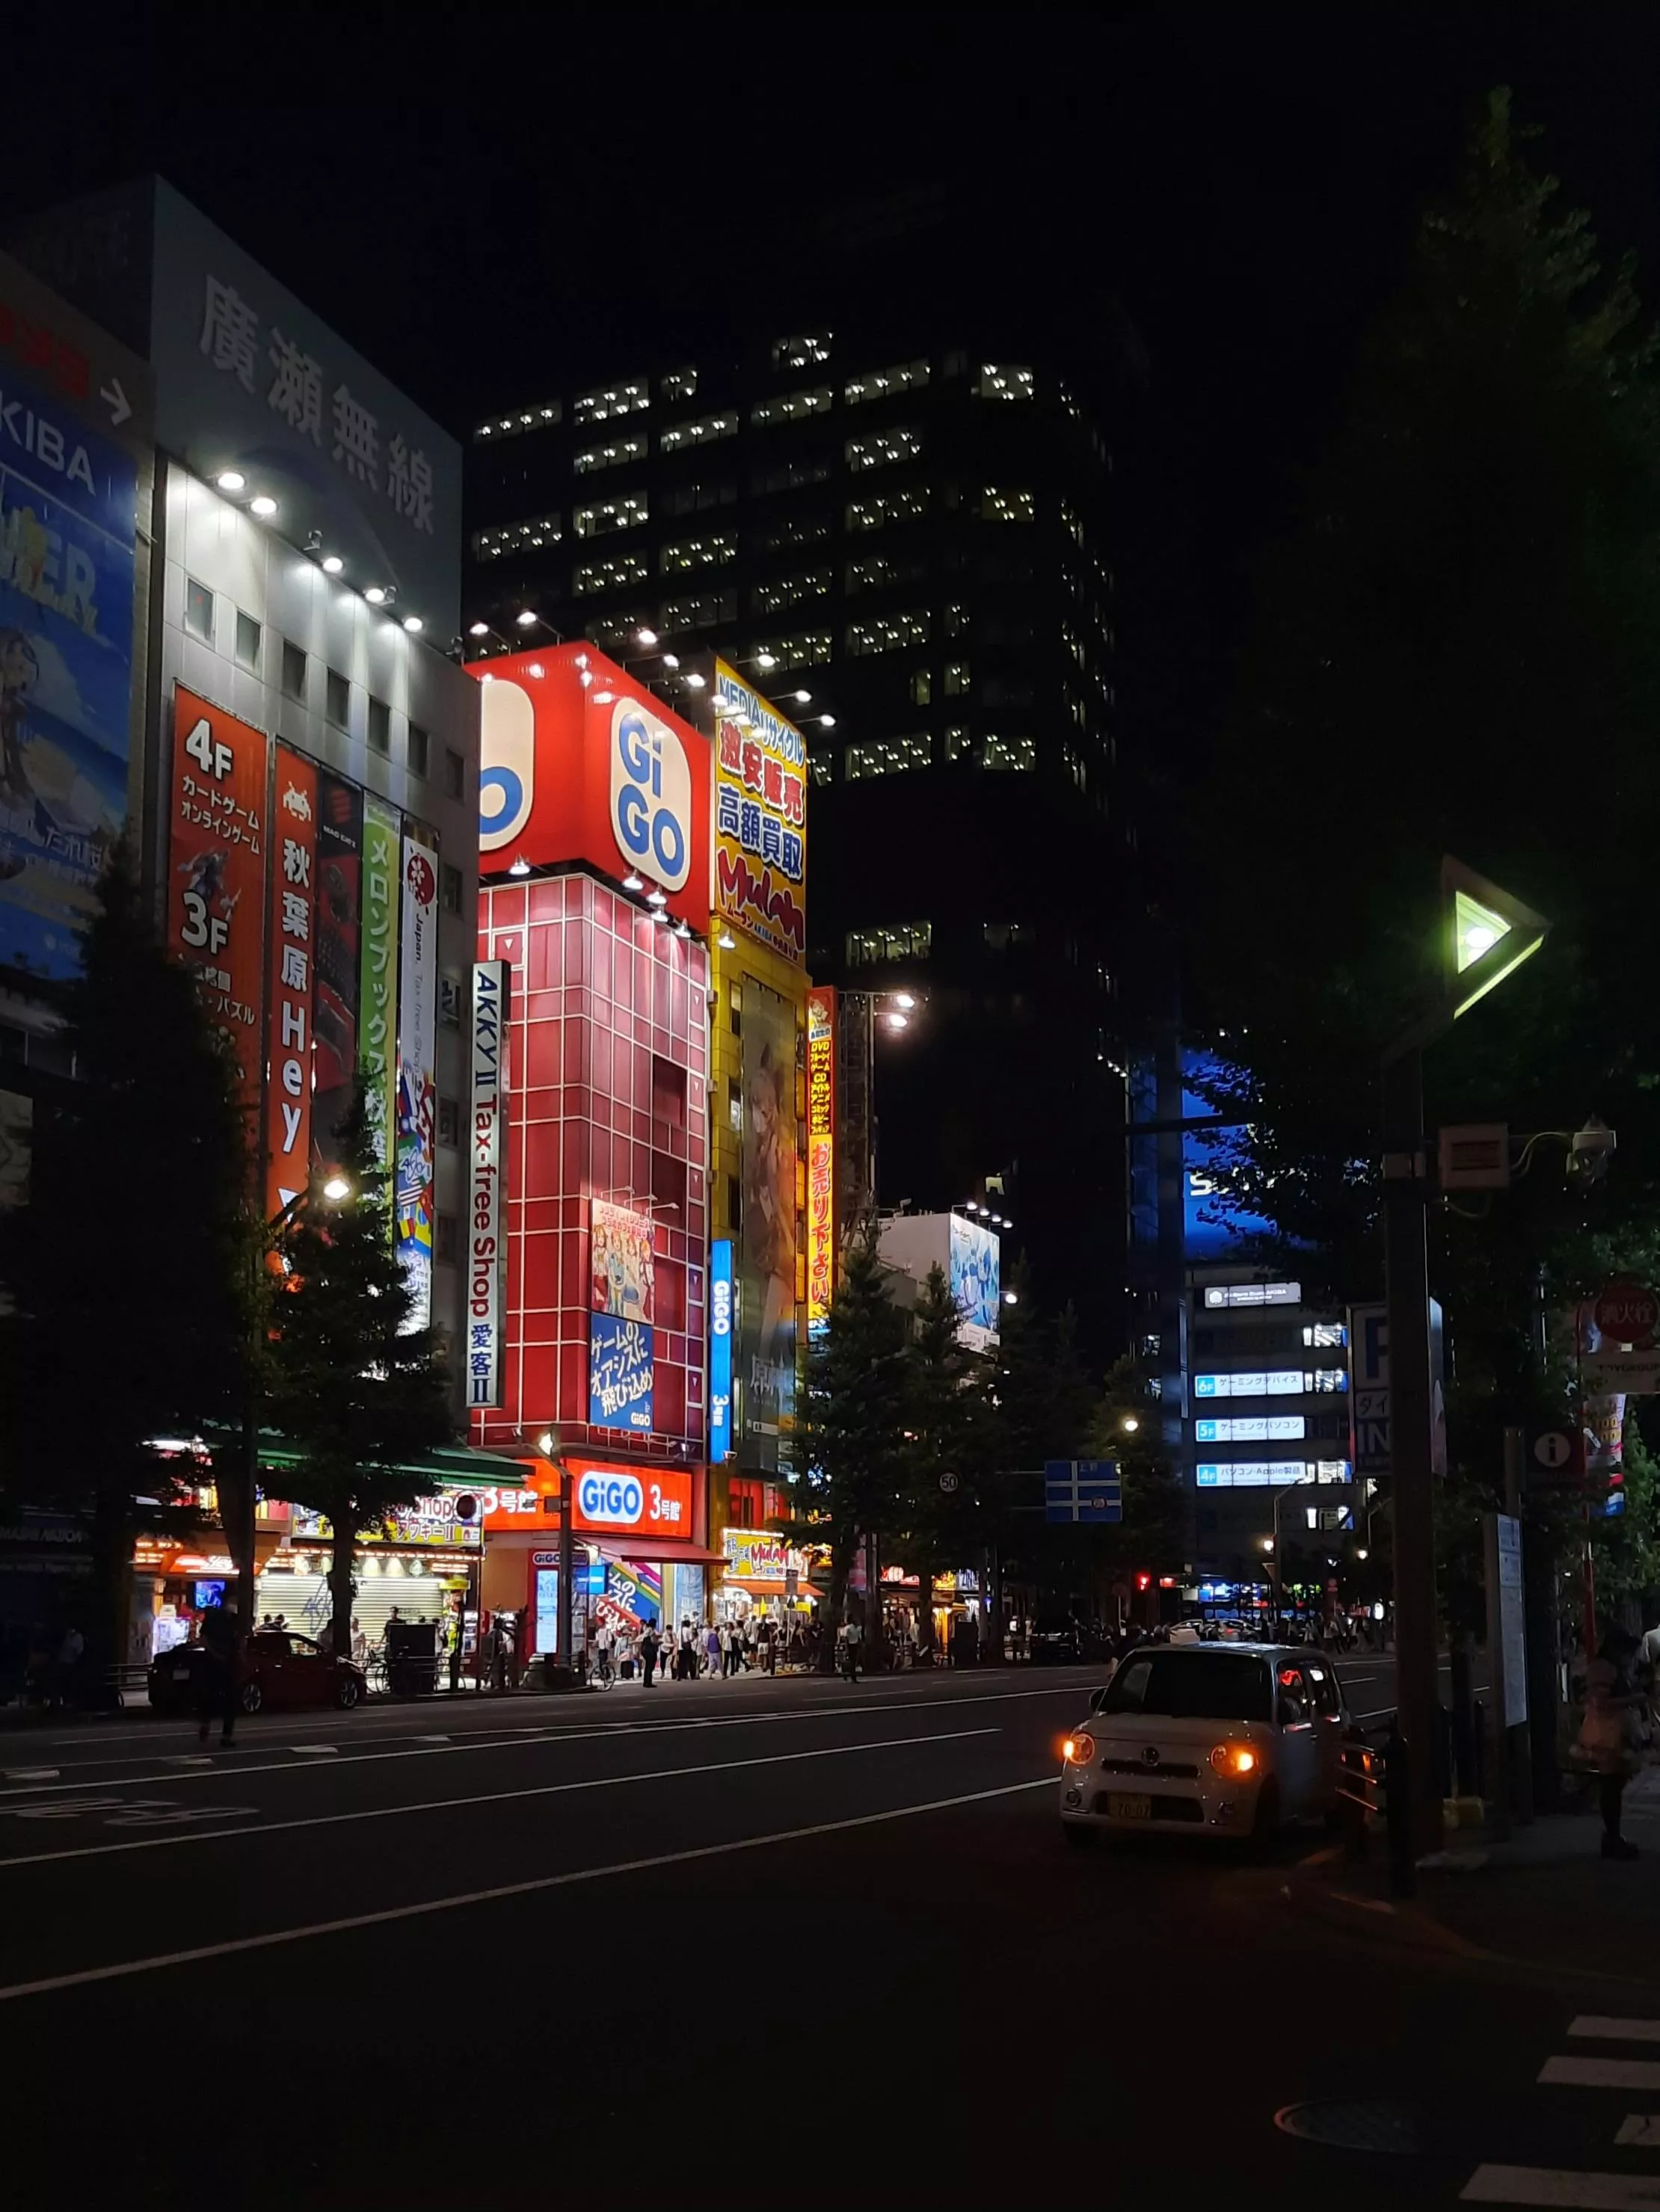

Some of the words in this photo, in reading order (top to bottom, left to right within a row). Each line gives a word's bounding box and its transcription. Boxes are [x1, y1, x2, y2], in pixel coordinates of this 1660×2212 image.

[200, 274, 434, 535] 廣瀬無線
[186, 719, 234, 780] 4F
[720, 722, 803, 825] 激安販売
[180, 801, 260, 855] オンラインゲーム
[182, 775, 260, 831] カードゲーム
[719, 785, 803, 879] 高額買取
[180, 891, 228, 955] 3F
[476, 970, 497, 1065] AKKY
[811, 1042, 829, 1052] DVD
[811, 1062, 830, 1073] ゲーム
[814, 1073, 826, 1082] CD
[475, 1094, 497, 1230] Tax-free
[811, 1143, 830, 1304] お売り下さい
[470, 1236, 496, 1317] Shop
[1602, 1301, 1653, 1324] 消火栓
[1199, 1380, 1214, 1392] 6F
[1220, 1375, 1297, 1387] ゲーミングデバイス
[630, 1413, 651, 1426] GiGO
[1200, 1425, 1215, 1436] 5F
[1220, 1421, 1299, 1432] ゲーミングパソコン
[583, 1479, 639, 1515] GiGO
[649, 1485, 682, 1521] 3号館
[942, 1476, 956, 1488] 50
[1199, 1469, 1215, 1481] 4F
